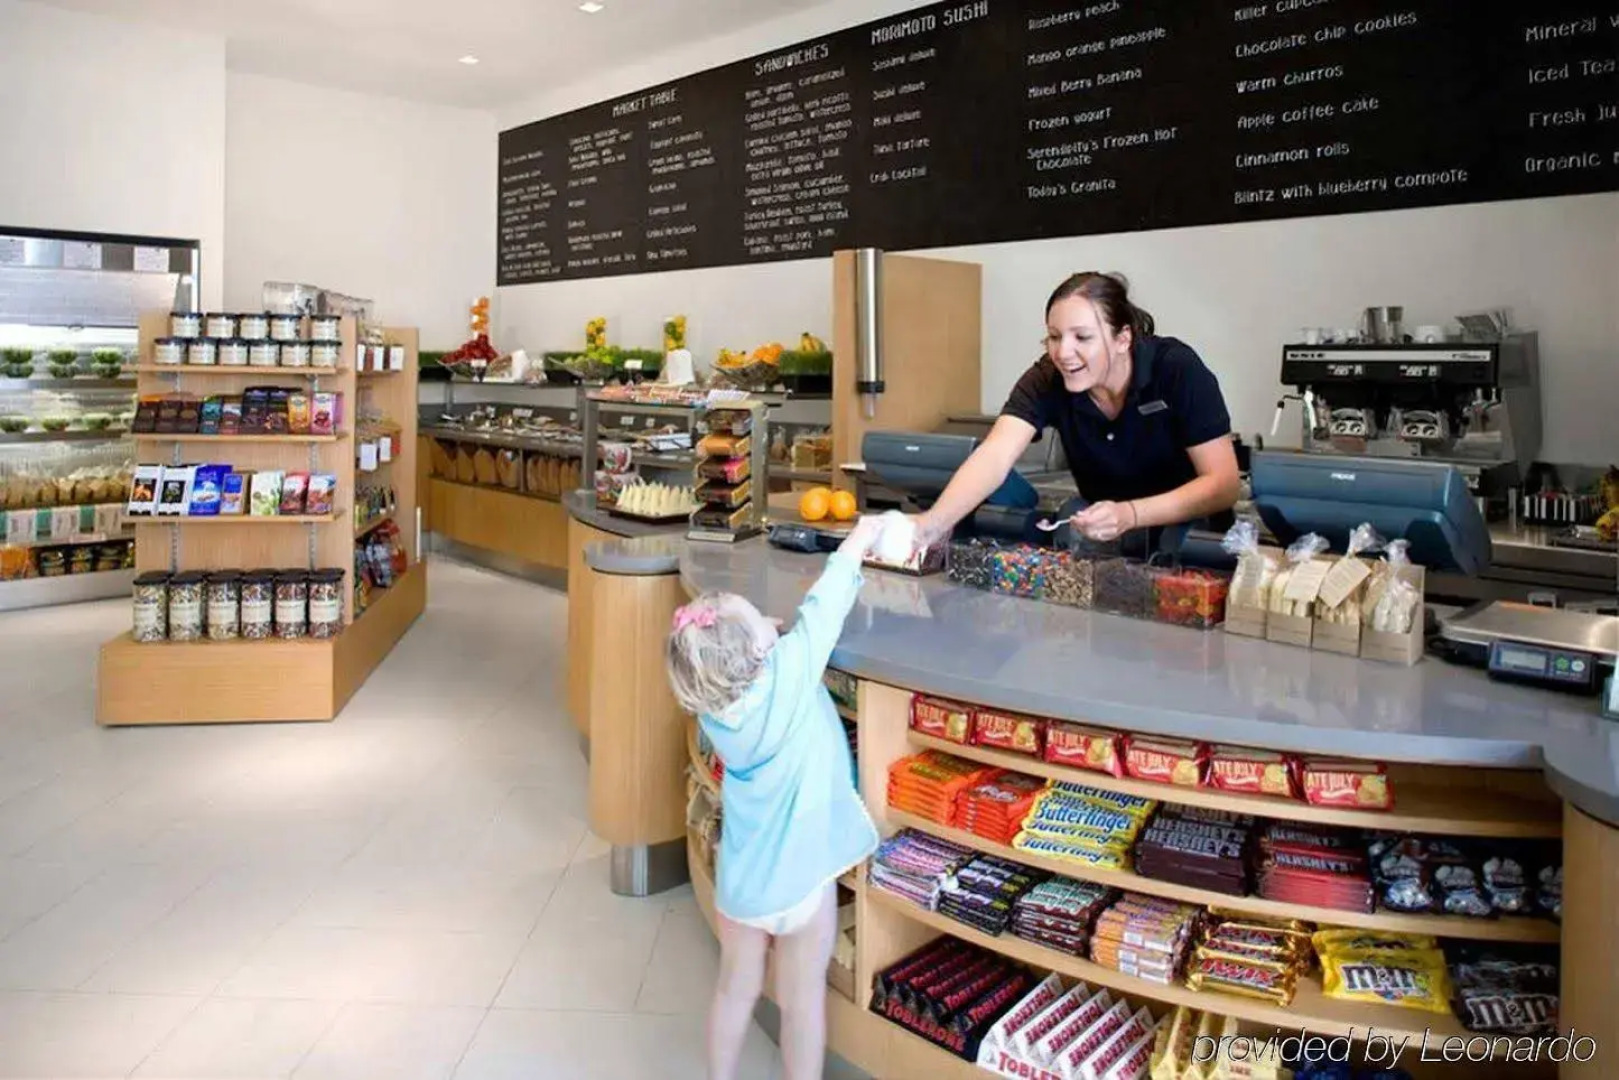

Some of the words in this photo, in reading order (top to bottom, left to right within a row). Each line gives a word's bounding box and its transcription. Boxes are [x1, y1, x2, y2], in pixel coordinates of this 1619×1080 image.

[871, 15, 936, 46] MORIMOTO
[943, 0, 988, 26] SUSHI
[1235, 33, 1307, 58] Chocolate
[1314, 25, 1346, 42] chip
[1354, 12, 1417, 34] cookies
[1525, 17, 1597, 43] Mineral
[1066, 42, 1105, 58] orange
[1110, 27, 1166, 49] pineapple
[754, 43, 829, 76] SANDWICHES
[1528, 63, 1570, 84] Iced
[1580, 58, 1616, 77] Tea
[1060, 78, 1092, 93] Berry
[1096, 68, 1142, 86] Banana
[1236, 77, 1276, 94] Warm
[1283, 64, 1344, 86] churros
[612, 97, 646, 118] MARKET
[1028, 115, 1069, 131] Frozen
[1074, 107, 1112, 124] yogurt
[1237, 115, 1275, 129] Apple
[1282, 104, 1334, 123] coffee
[1342, 97, 1379, 113] cake
[1529, 107, 1586, 128] Fresh
[1027, 140, 1099, 160] Serendipity's
[1103, 132, 1148, 149] Frozen
[1236, 149, 1309, 168] Cinnamon
[1316, 142, 1350, 157] rolls
[1036, 154, 1092, 171] Chocolate
[1525, 152, 1601, 173] Organic
[1027, 184, 1067, 199] Today's
[1071, 178, 1116, 195] Granita
[1234, 189, 1275, 205] Blintz
[1281, 184, 1313, 201] with
[1318, 176, 1387, 196] blueberry
[1395, 168, 1468, 188] compote
[1144, 828, 1241, 858] HERSHEY'S
[1275, 851, 1350, 872] HERSHEY'S
[885, 996, 966, 1052] TOBLERONE
